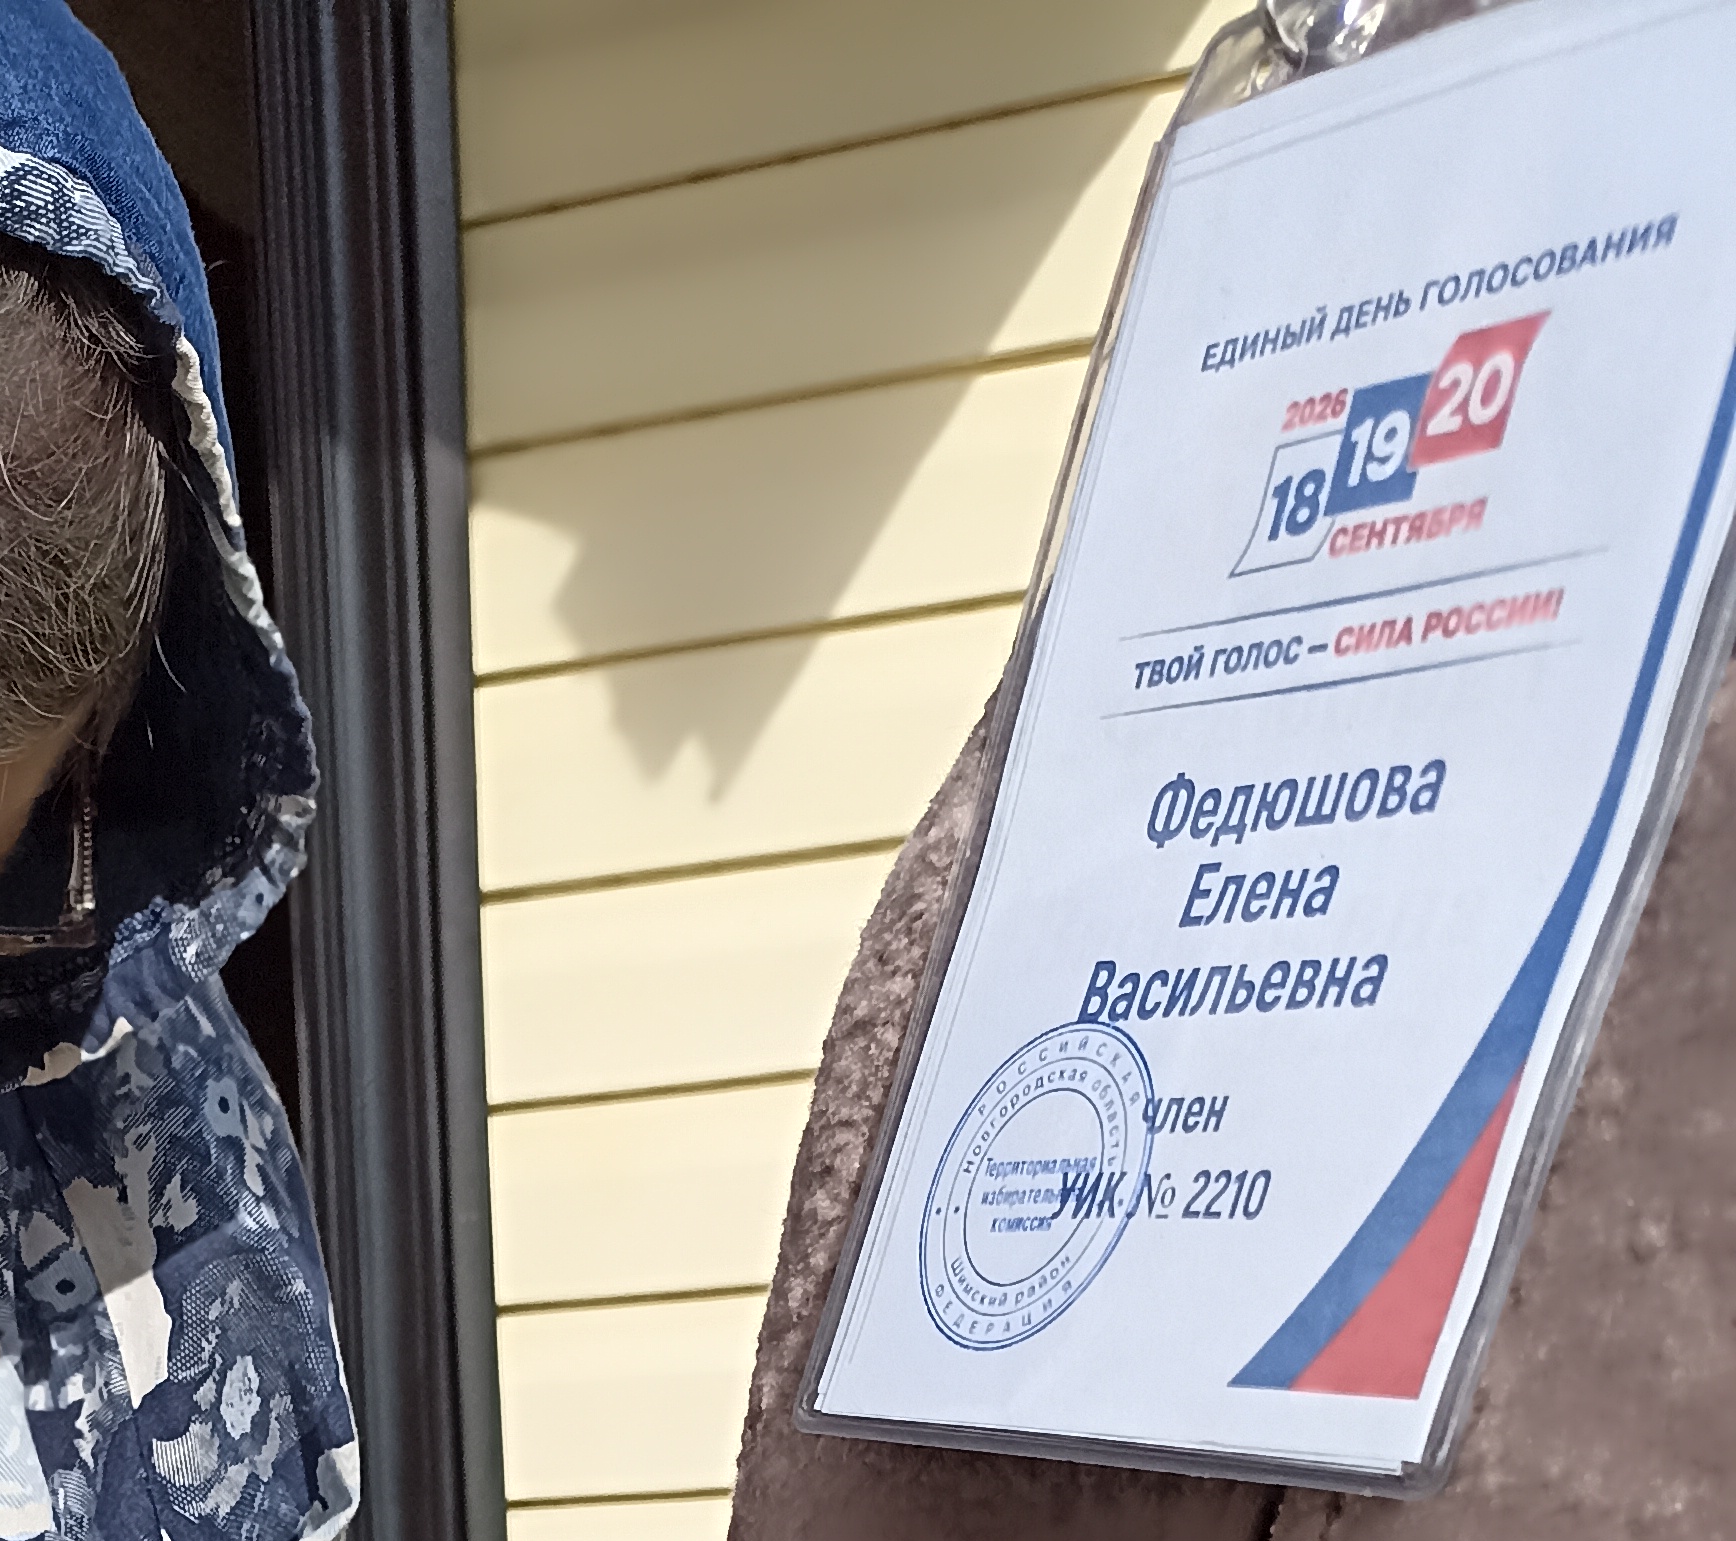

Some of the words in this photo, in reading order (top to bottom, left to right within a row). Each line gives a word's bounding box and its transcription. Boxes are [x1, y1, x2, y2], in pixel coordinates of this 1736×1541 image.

[1200, 306, 1328, 373] ЕДИНЫЙ
[1330, 289, 1413, 336] ДЕНЬ
[1419, 212, 1679, 311] ГОЛОСОВАНИЯ
[1280, 388, 1349, 433] 2026
[1267, 468, 1327, 542] 18
[1347, 409, 1411, 487] 19
[1426, 350, 1516, 437] 20
[1328, 496, 1488, 559] СЕНТЯБРЯ
[1134, 646, 1204, 690] ТВОЙ
[1209, 636, 1304, 678] ГОЛОС
[1333, 616, 1414, 657] СИЛА
[1421, 586, 1567, 643] РОССИИ!
[1146, 758, 1447, 848] Федюшова
[1178, 862, 1341, 928] Елена
[1076, 953, 1390, 1024] Васильевна
[1141, 1092, 1230, 1135] член
[1050, 1171, 1127, 1220] УИК
[1181, 1169, 1272, 1220] 2210
